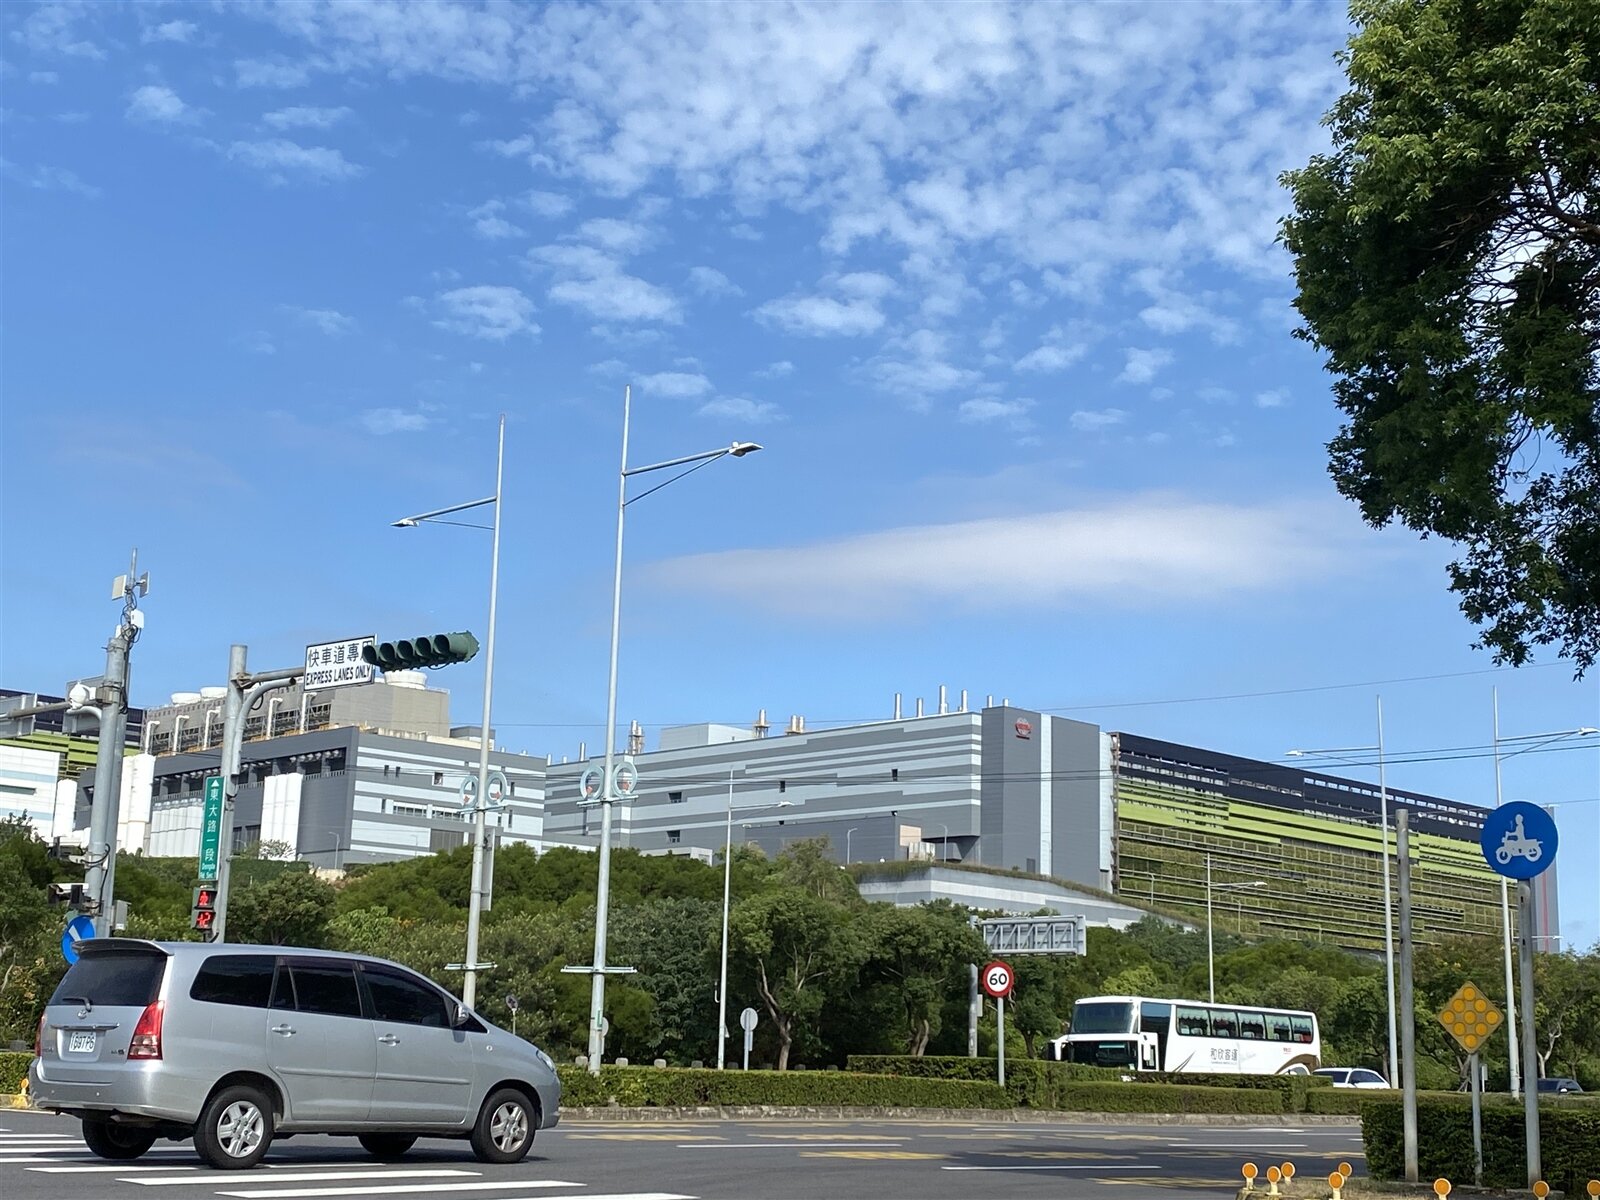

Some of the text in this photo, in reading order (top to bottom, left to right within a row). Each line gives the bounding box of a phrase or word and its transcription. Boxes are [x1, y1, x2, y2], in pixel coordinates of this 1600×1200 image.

[306, 664, 371, 686] EXPRESS LANES ONLY
[205, 788, 219, 862] 東大路一段
[990, 973, 1007, 985] 60
